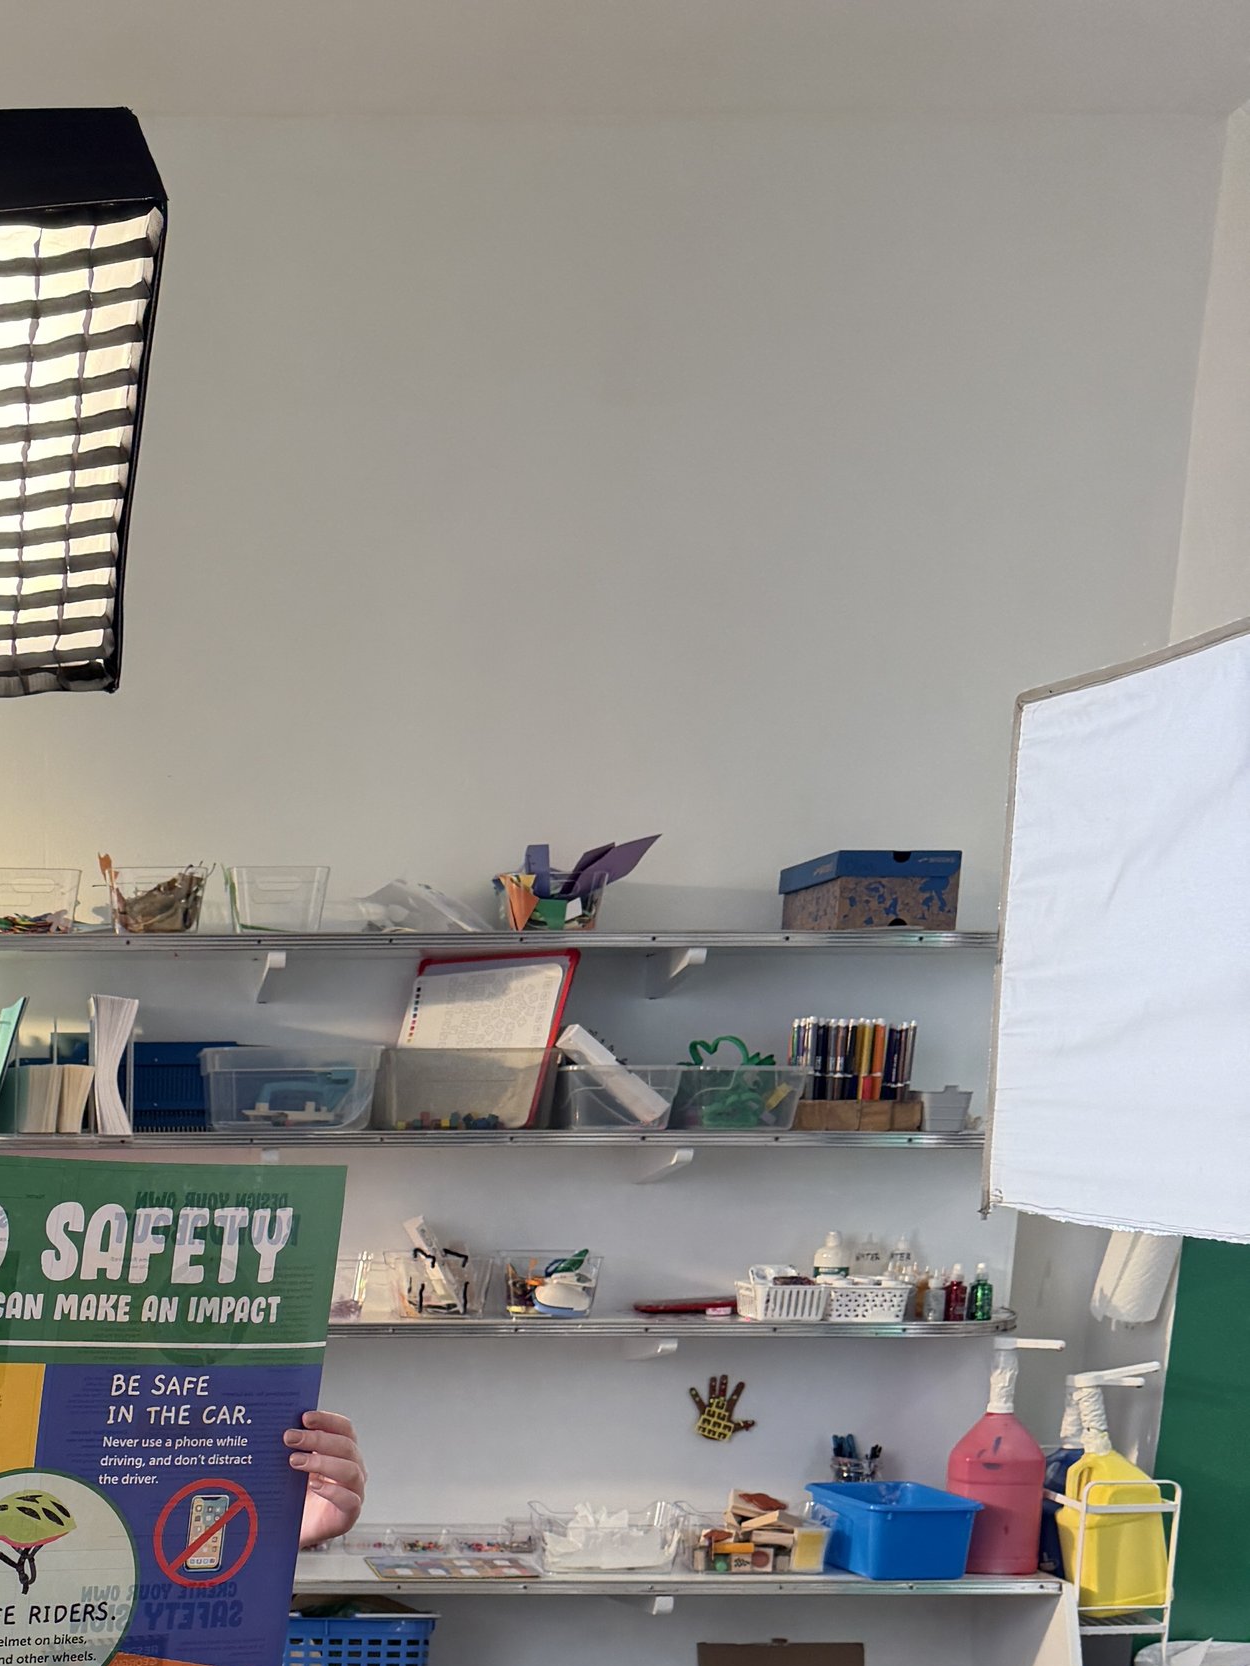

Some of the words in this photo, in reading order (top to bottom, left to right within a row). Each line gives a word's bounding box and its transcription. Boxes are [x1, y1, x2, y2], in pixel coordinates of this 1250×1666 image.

[41, 1202, 293, 1284] SAFETY
[53, 1294, 132, 1323] MAKE
[141, 1295, 179, 1323] AN
[187, 1296, 281, 1324] IMPACT
[111, 1374, 141, 1396] BE
[151, 1374, 210, 1396] SAFE
[106, 1405, 134, 1424] IN
[146, 1405, 191, 1425] THE
[202, 1405, 252, 1425] CAR.
[103, 1436, 139, 1447] Never
[142, 1438, 162, 1447] use
[165, 1439, 172, 1447] a
[175, 1436, 214, 1450] phone
[216, 1435, 248, 1447] while
[100, 1454, 146, 1468] driving,
[149, 1454, 171, 1466] and
[208, 1454, 253, 1465] distract
[98, 1474, 119, 1484] the
[121, 1474, 159, 1484] driver.
[28, 1601, 116, 1625] RIDERS.
[35, 1637, 50, 1646] on
[53, 1634, 87, 1646] bikes,
[16, 1654, 49, 1665] other
[52, 1651, 96, 1663] wheels.
